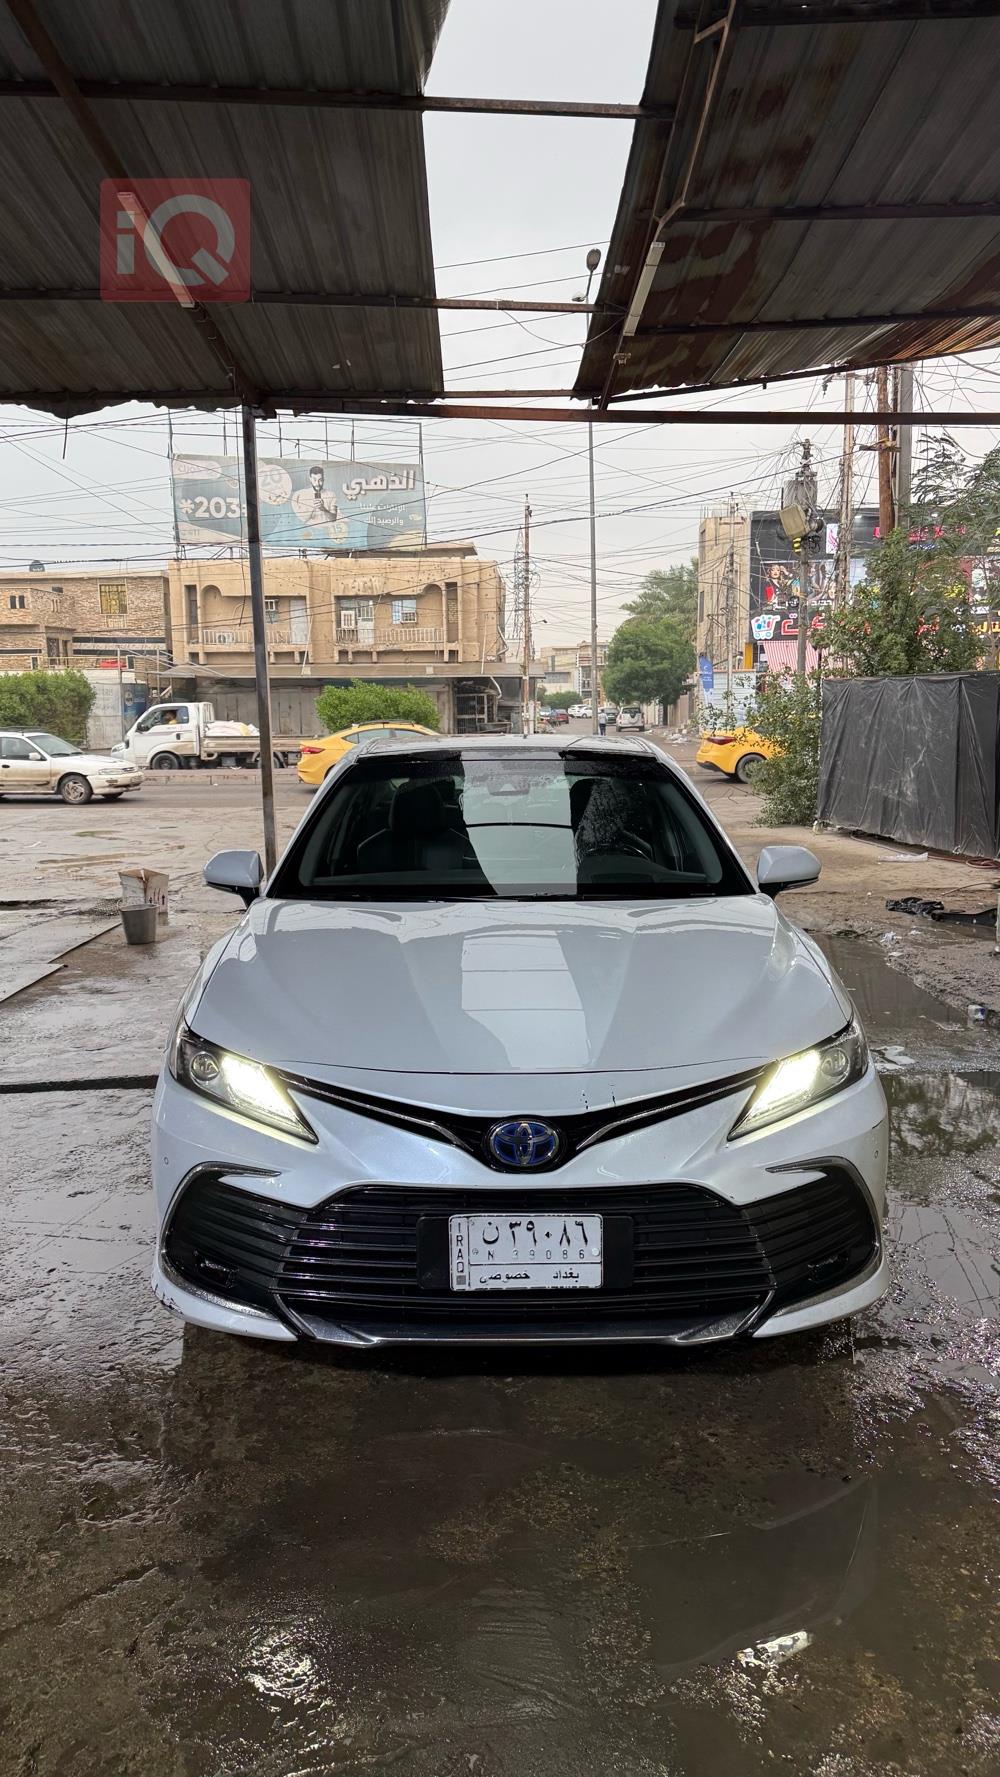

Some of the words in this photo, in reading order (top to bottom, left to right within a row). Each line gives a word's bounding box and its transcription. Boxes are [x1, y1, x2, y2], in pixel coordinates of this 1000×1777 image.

[342, 469, 415, 500] الذهبي
[482, 1221, 500, 1245] ن
[508, 1220, 588, 1247] ٣٩٠٨٦
[456, 1222, 465, 1273] IRAQ
[487, 1249, 494, 1260] N
[512, 1249, 585, 1260] 39086
[479, 1270, 531, 1285] خصوصي
[552, 1268, 580, 1283] بغداد
